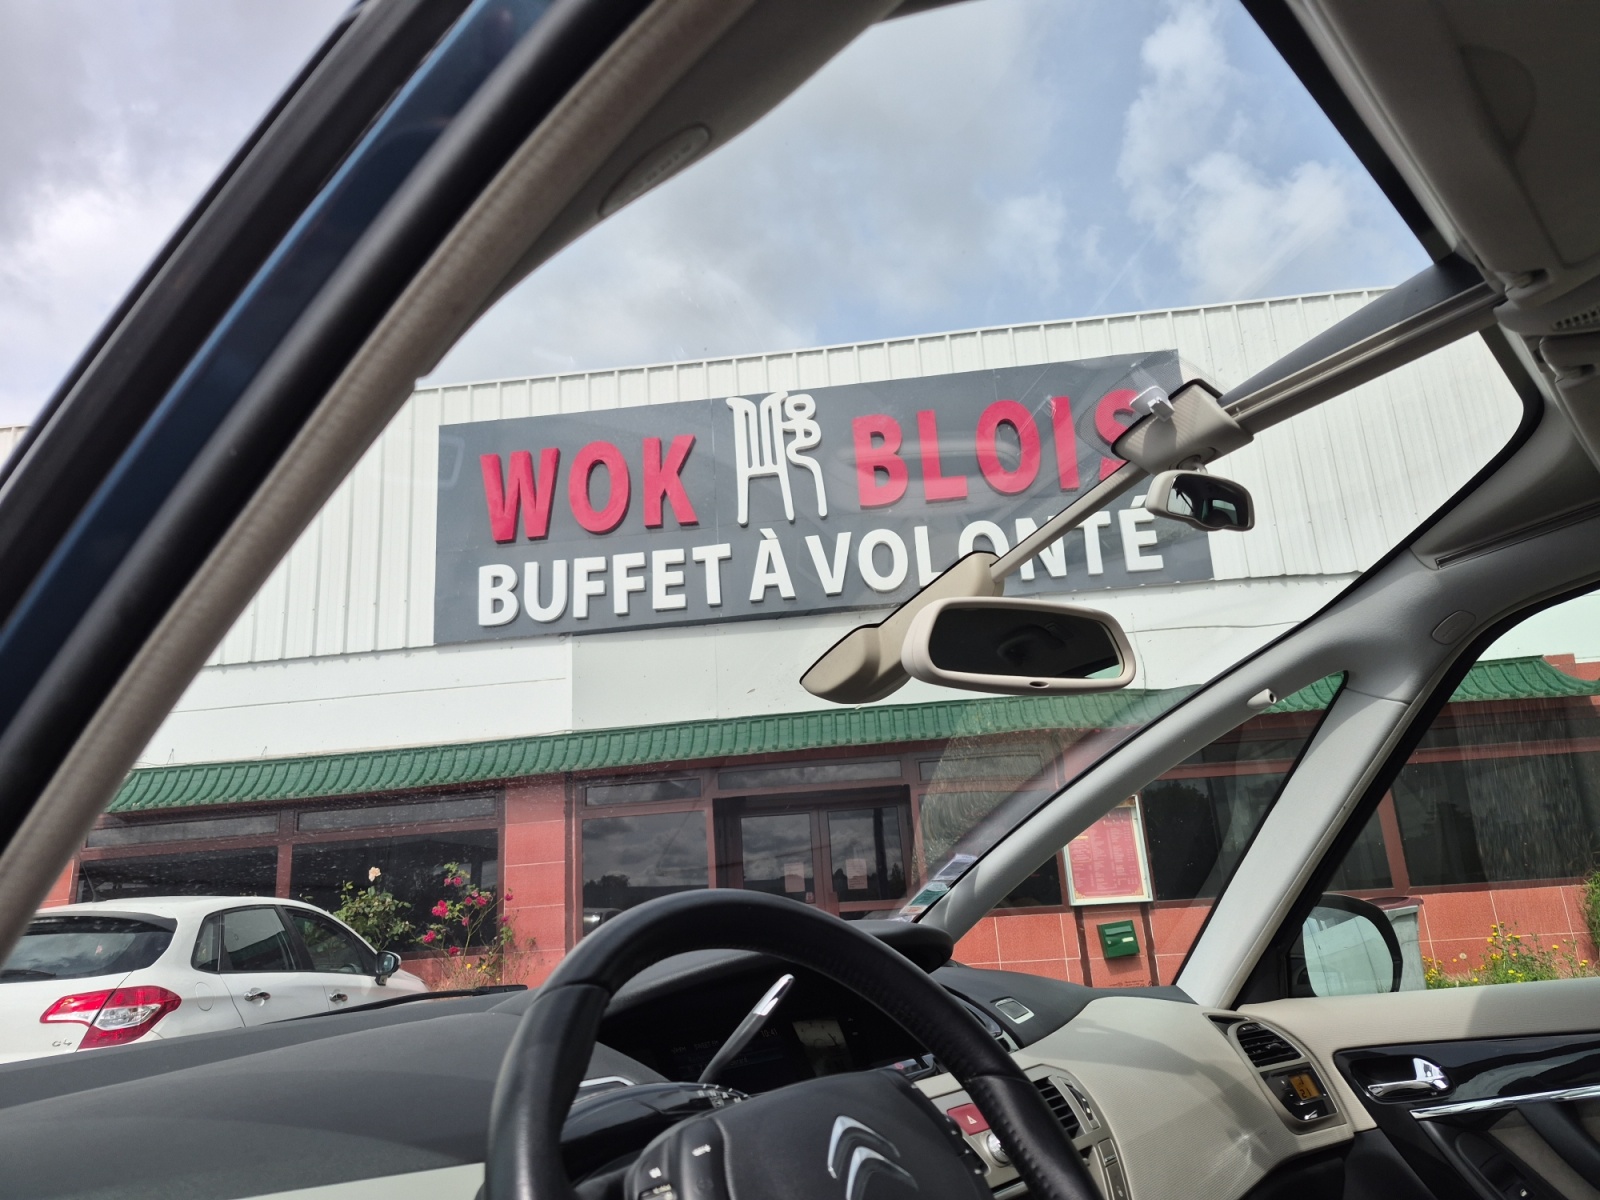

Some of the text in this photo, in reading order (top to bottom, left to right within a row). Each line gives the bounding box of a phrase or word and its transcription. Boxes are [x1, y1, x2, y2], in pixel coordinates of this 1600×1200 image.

[479, 434, 700, 544] WOK
[477, 543, 732, 627] BUFFET
[749, 527, 797, 602] À
